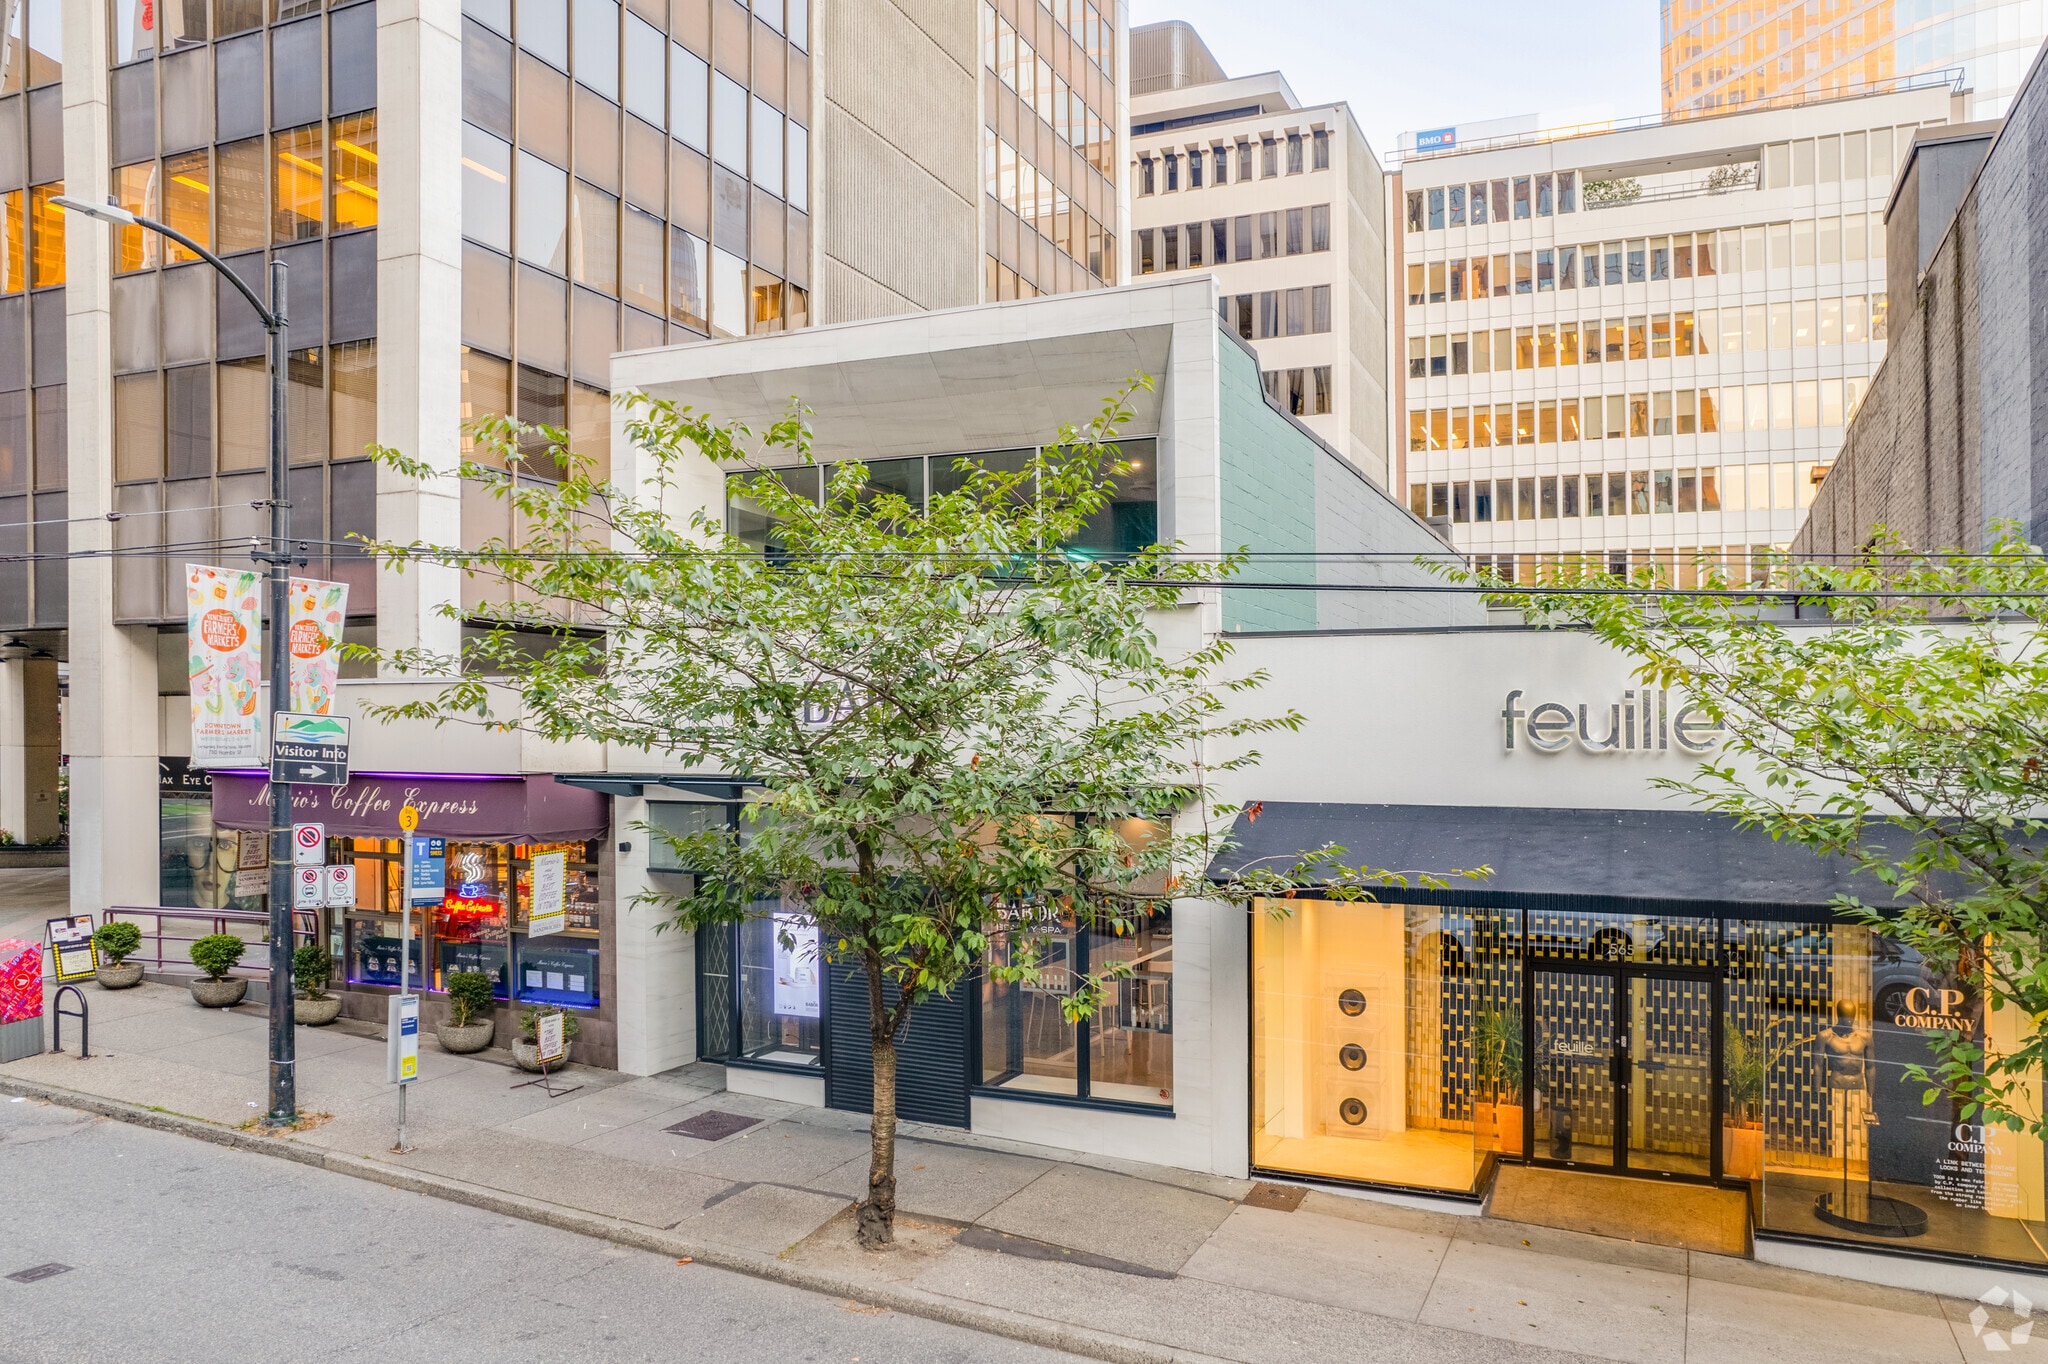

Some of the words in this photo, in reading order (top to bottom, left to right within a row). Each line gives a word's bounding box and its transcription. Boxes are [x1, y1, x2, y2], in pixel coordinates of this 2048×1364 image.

[1419, 136, 1441, 146] BMO
[207, 614, 233, 622] VANCOUVER
[204, 620, 237, 636] FARMERS
[208, 634, 239, 647] MARKETS
[292, 643, 320, 654] MARKETS
[1501, 689, 1726, 752] feuille
[275, 745, 318, 757] Visitor
[322, 748, 346, 759] Info
[249, 783, 319, 808] Mio's
[331, 785, 391, 817] Coffee
[402, 788, 478, 819] Express
[406, 816, 412, 827] 3
[416, 842, 426, 856] T
[446, 899, 465, 914] Coffee
[466, 900, 493, 914] Express
[1610, 944, 1634, 955] 565
[1905, 987, 1964, 1017] C.P.
[1894, 1014, 1975, 1032] COMPANY
[1554, 1040, 1594, 1053] feuille
[1955, 1124, 1996, 1146] C.P.
[1948, 1142, 2003, 1156] COMPANY
[1976, 1168, 2012, 1177] TECHNOLOGY
